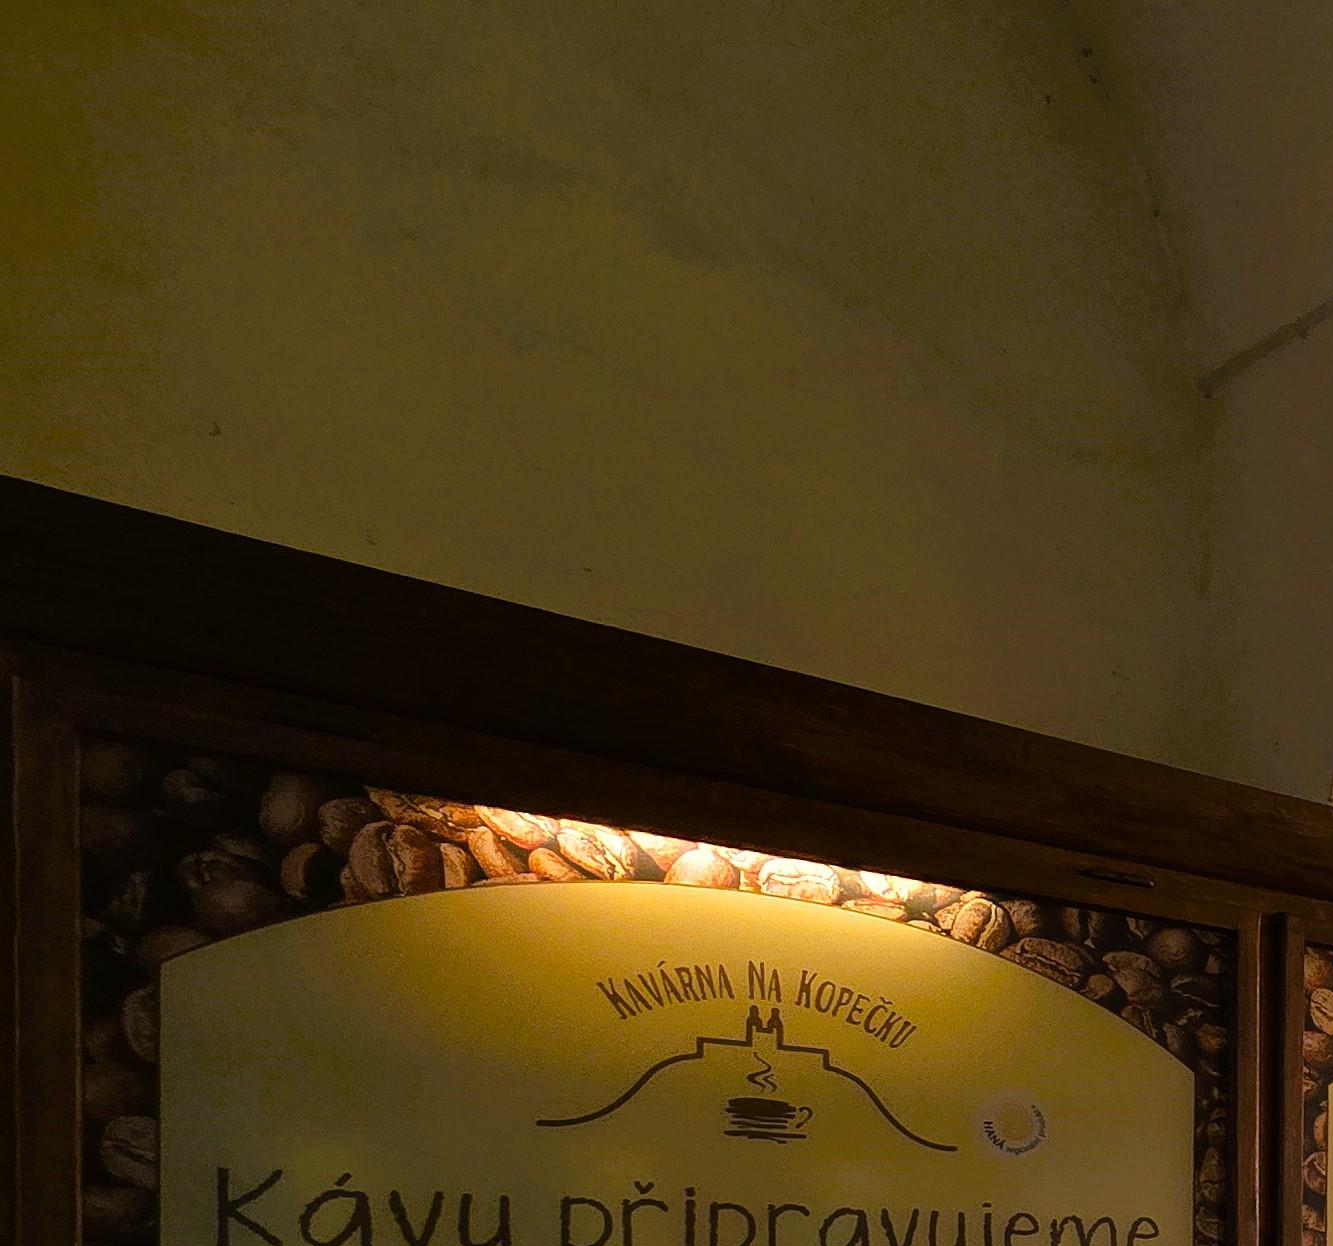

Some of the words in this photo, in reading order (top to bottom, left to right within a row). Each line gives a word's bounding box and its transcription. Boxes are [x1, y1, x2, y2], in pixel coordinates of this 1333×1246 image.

[597, 961, 732, 1019] KAVÁRNA
[747, 960, 786, 1002] NA
[796, 969, 917, 1049] KOPEČKU
